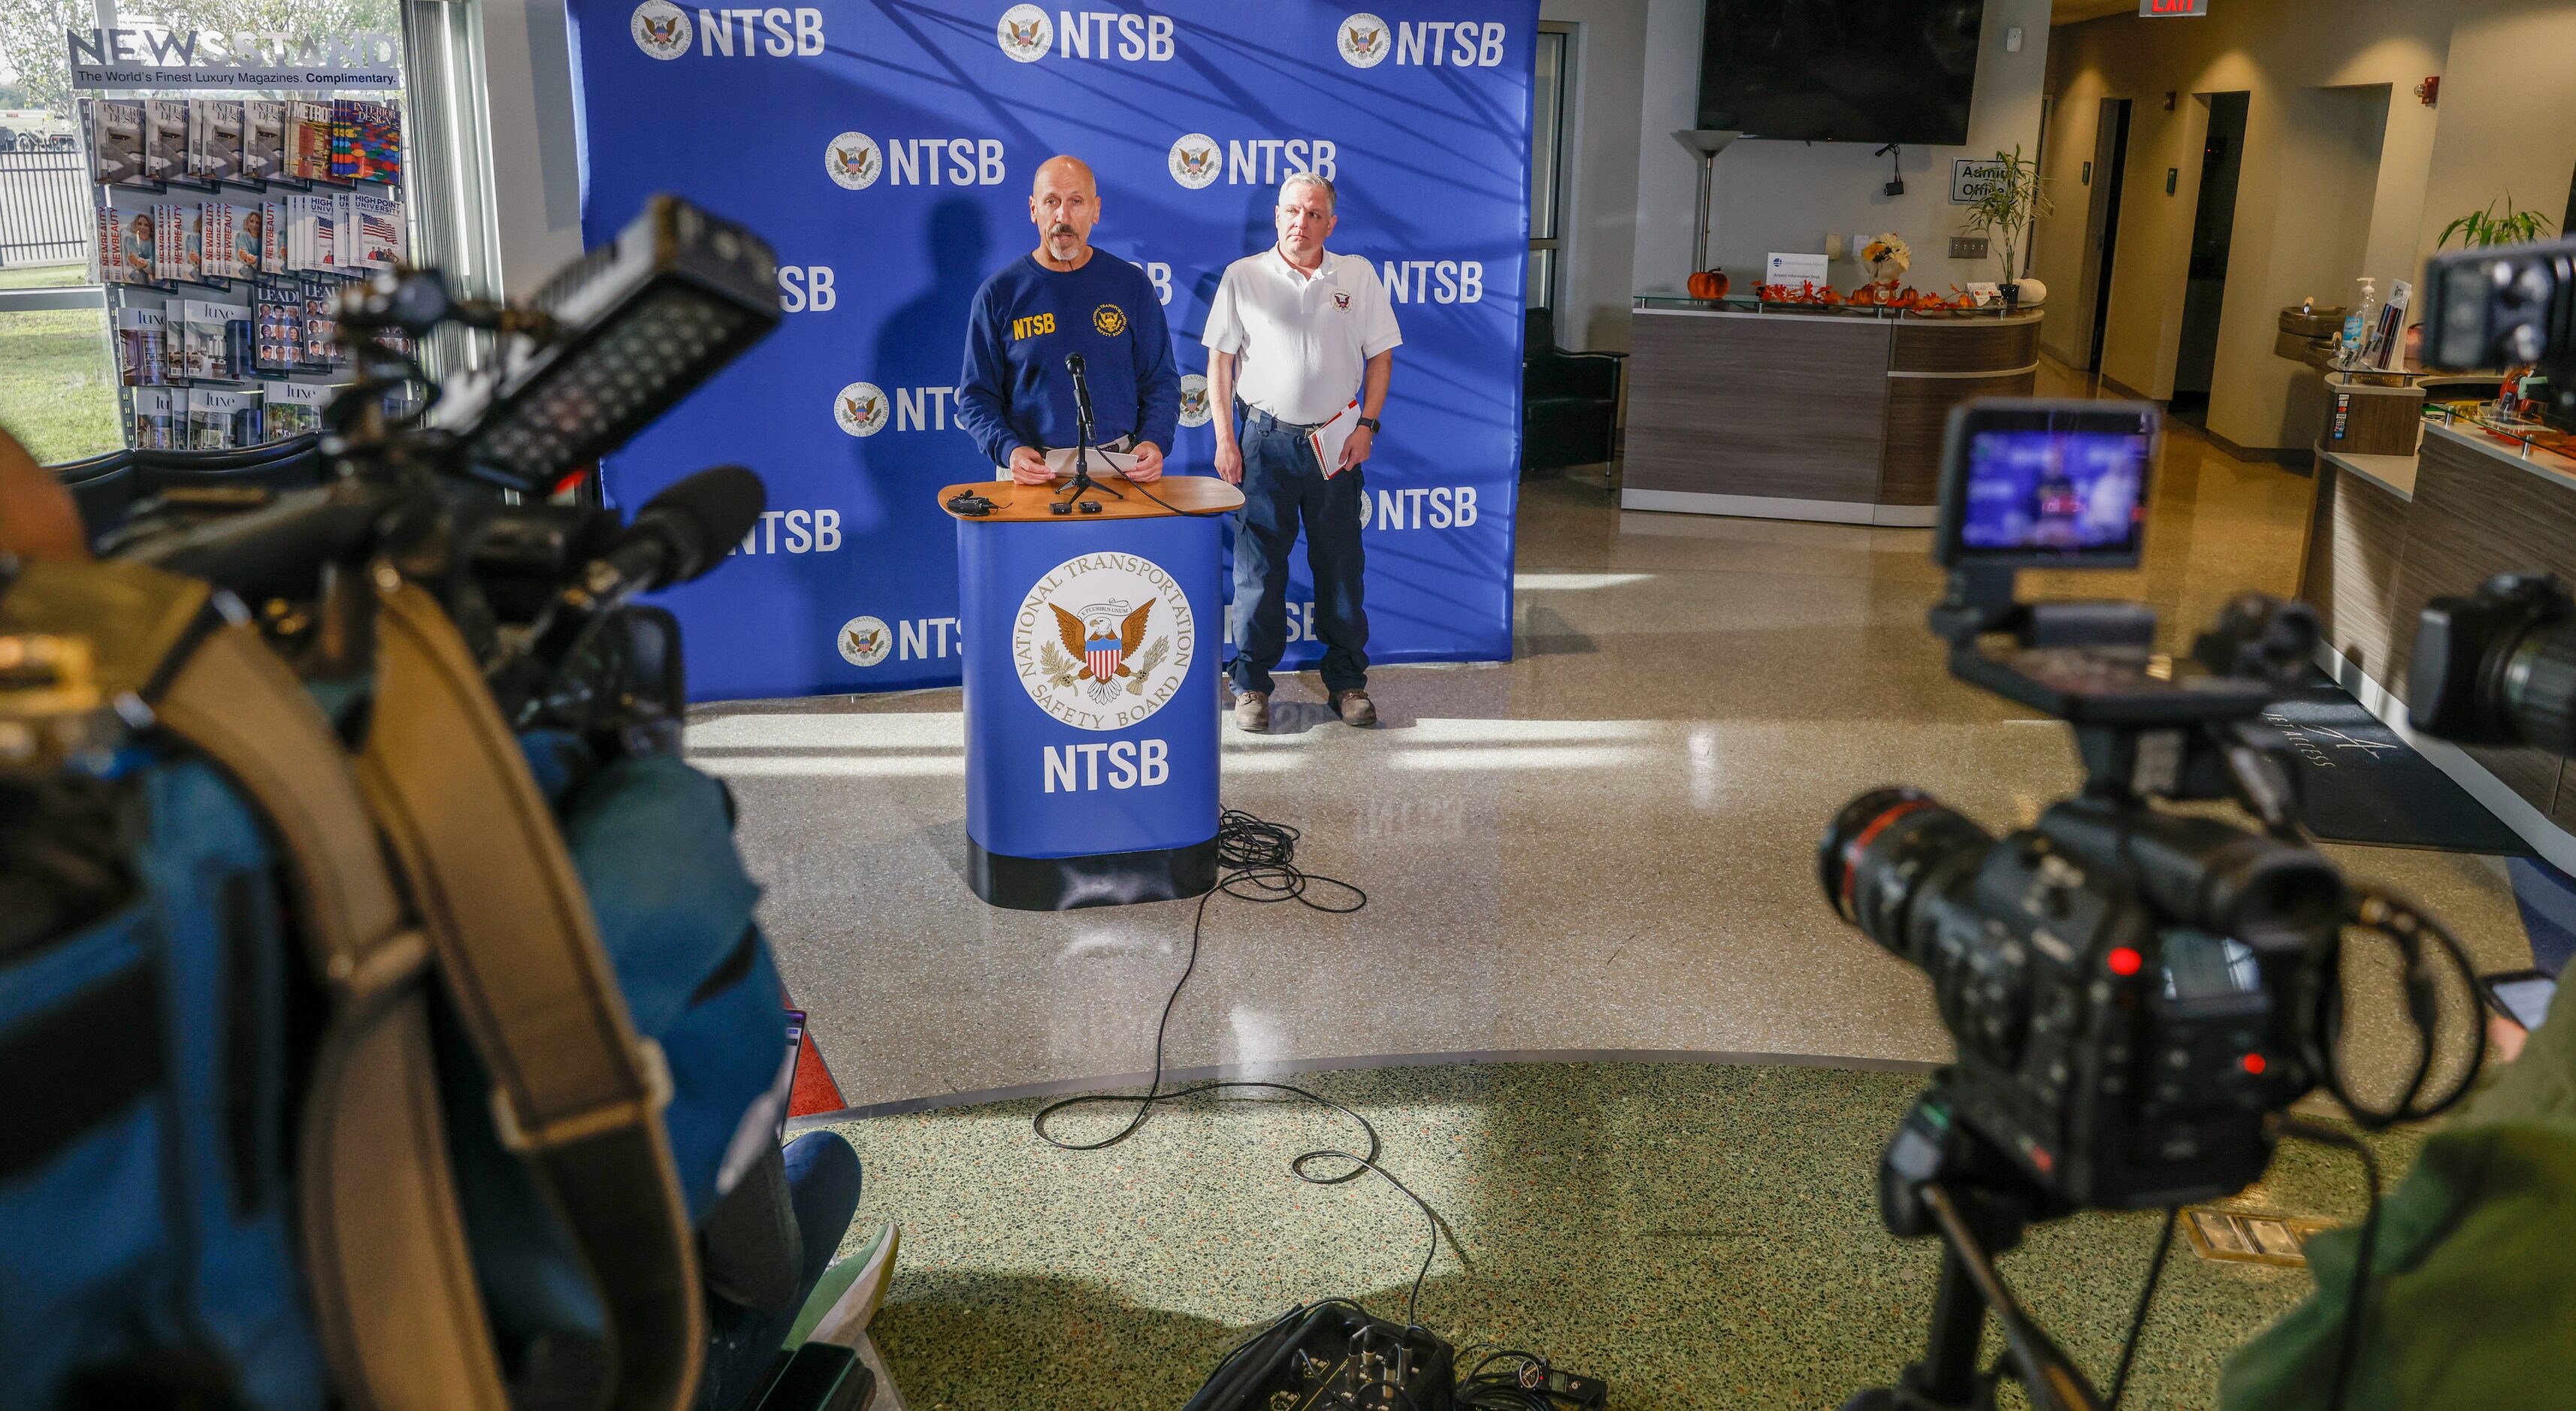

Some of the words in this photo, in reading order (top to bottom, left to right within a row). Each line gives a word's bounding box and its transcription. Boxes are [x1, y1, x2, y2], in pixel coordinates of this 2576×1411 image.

[67, 28, 398, 68] NEWSSTAND
[699, 7, 824, 57] NTSB
[1060, 11, 1175, 62] NTSB
[1396, 21, 1506, 67] NTSB
[78, 71, 102, 81] The
[106, 71, 152, 82] World's
[156, 72, 192, 82] Finest
[196, 72, 234, 85] Luxury
[238, 73, 302, 85] Magazines.
[306, 73, 396, 85] Complimentary.
[354, 102, 397, 119] INTERIOR
[358, 111, 392, 125] DESIGN
[889, 138, 1005, 186] NTSB
[1228, 139, 1337, 186] NTSB
[355, 195, 376, 204] HIGH
[377, 198, 401, 210] POINT
[355, 201, 401, 215] UNIVERSITY
[110, 207, 121, 267] NEWBEAUTY
[174, 206, 183, 264] NEWBEAUTY
[224, 204, 232, 261] NEWBEAUTY
[266, 202, 275, 259] NEWBEAUTY
[1383, 259, 1483, 305] NTSB
[205, 304, 234, 319] luxe
[1013, 313, 1055, 340] NTSB
[207, 392, 234, 407] luxe
[287, 384, 316, 399] luxe
[1378, 486, 1477, 530] NTSB
[727, 509, 842, 555] TSB
[1016, 575, 1063, 678] NATIONAL
[1063, 554, 1192, 669] TRANSPORTATION
[1032, 684, 1105, 730] SAFETY
[1116, 675, 1180, 727] BOARD
[1044, 739, 1169, 793] NTSB
[2281, 730, 2336, 767] ACCESS
